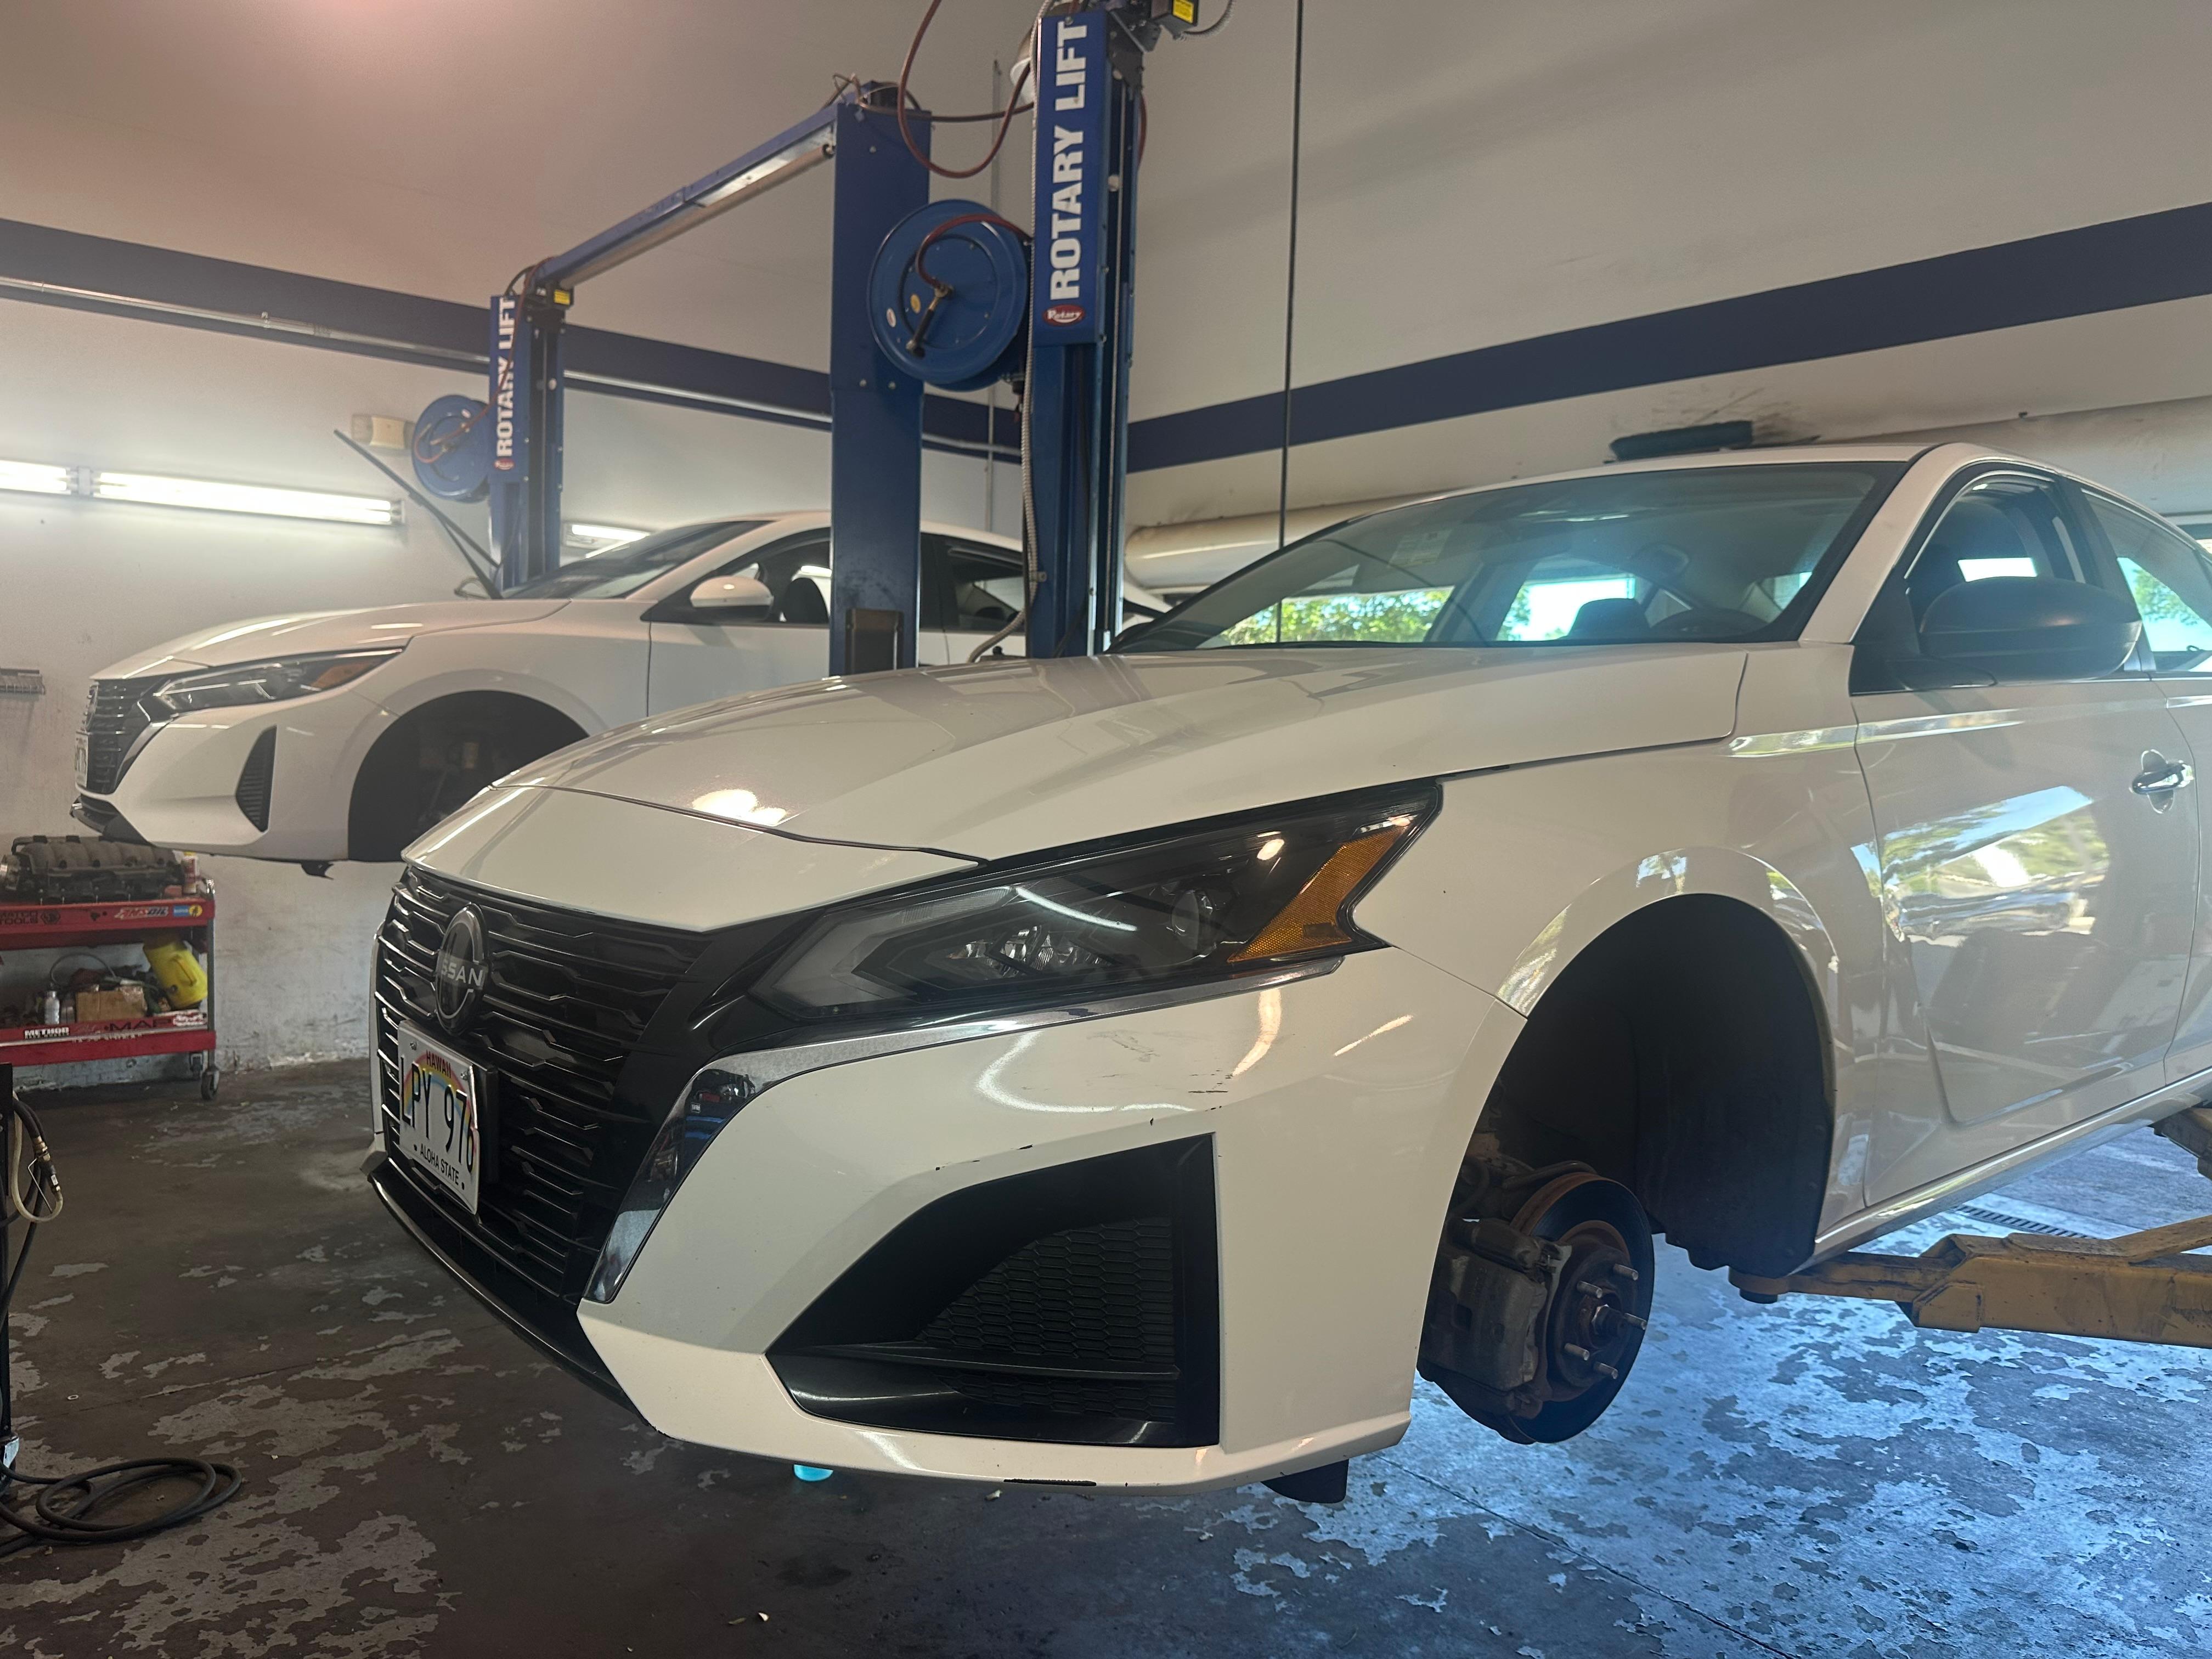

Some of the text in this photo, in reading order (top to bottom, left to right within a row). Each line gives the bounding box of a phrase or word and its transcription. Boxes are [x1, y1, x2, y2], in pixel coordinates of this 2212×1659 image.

[1050, 21, 1087, 300] ROTARY LIFT
[499, 297, 515, 349] LIFT
[496, 356, 514, 456] ROTARY
[400, 1054, 432, 1139] LPY
[426, 1050, 452, 1079] HAWAII
[420, 1143, 460, 1187] ALOHA STATE
